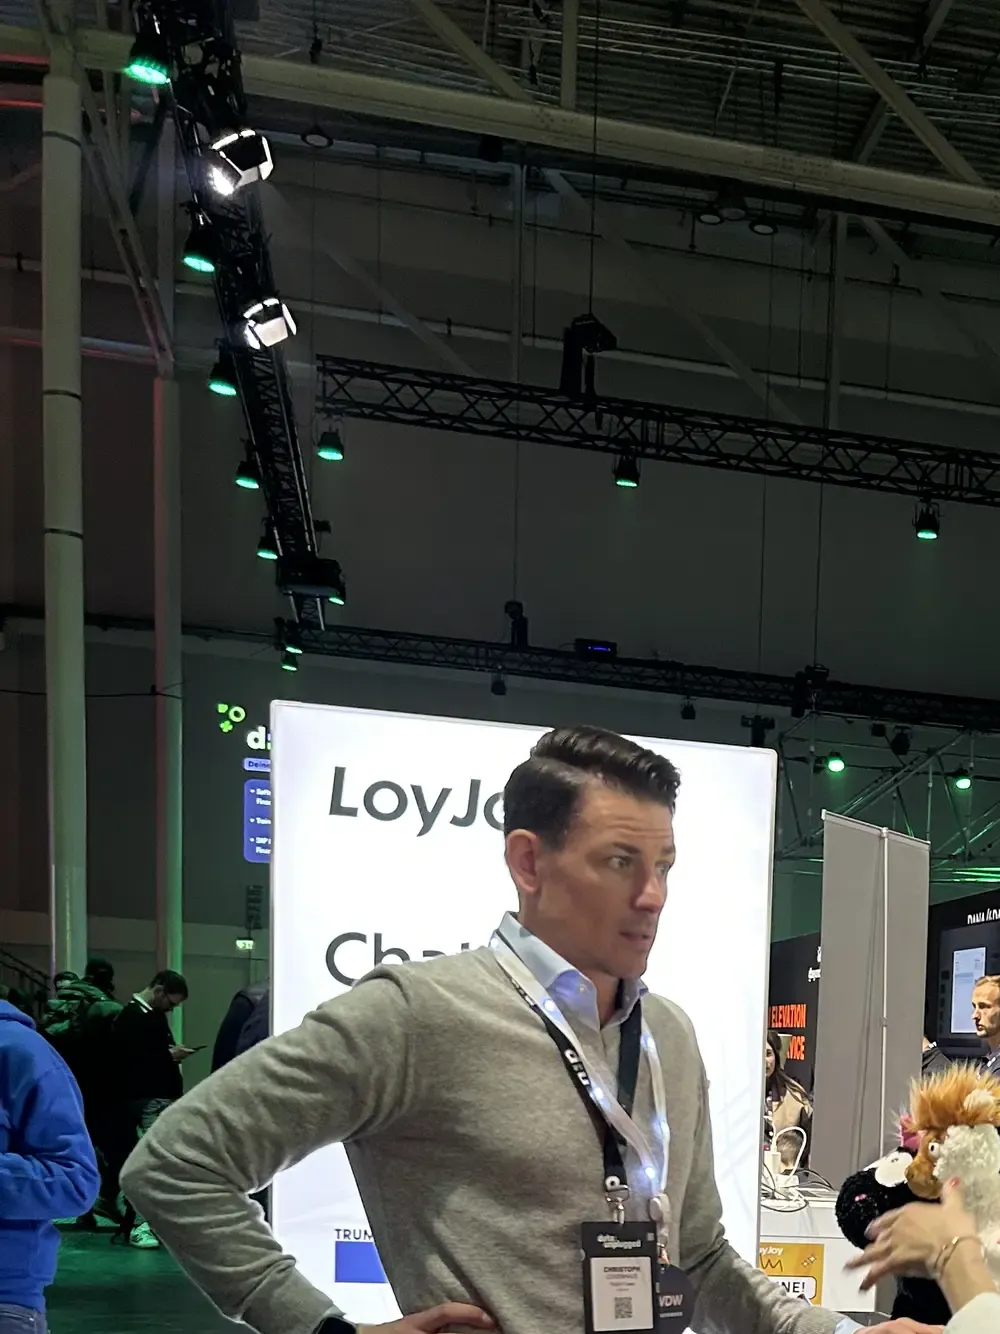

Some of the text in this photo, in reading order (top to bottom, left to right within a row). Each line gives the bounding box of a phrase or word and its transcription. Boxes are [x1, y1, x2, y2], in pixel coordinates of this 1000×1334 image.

[325, 932, 470, 987] Ch
[771, 1003, 807, 1028] ELEVATION
[780, 1281, 805, 1293] NE!
